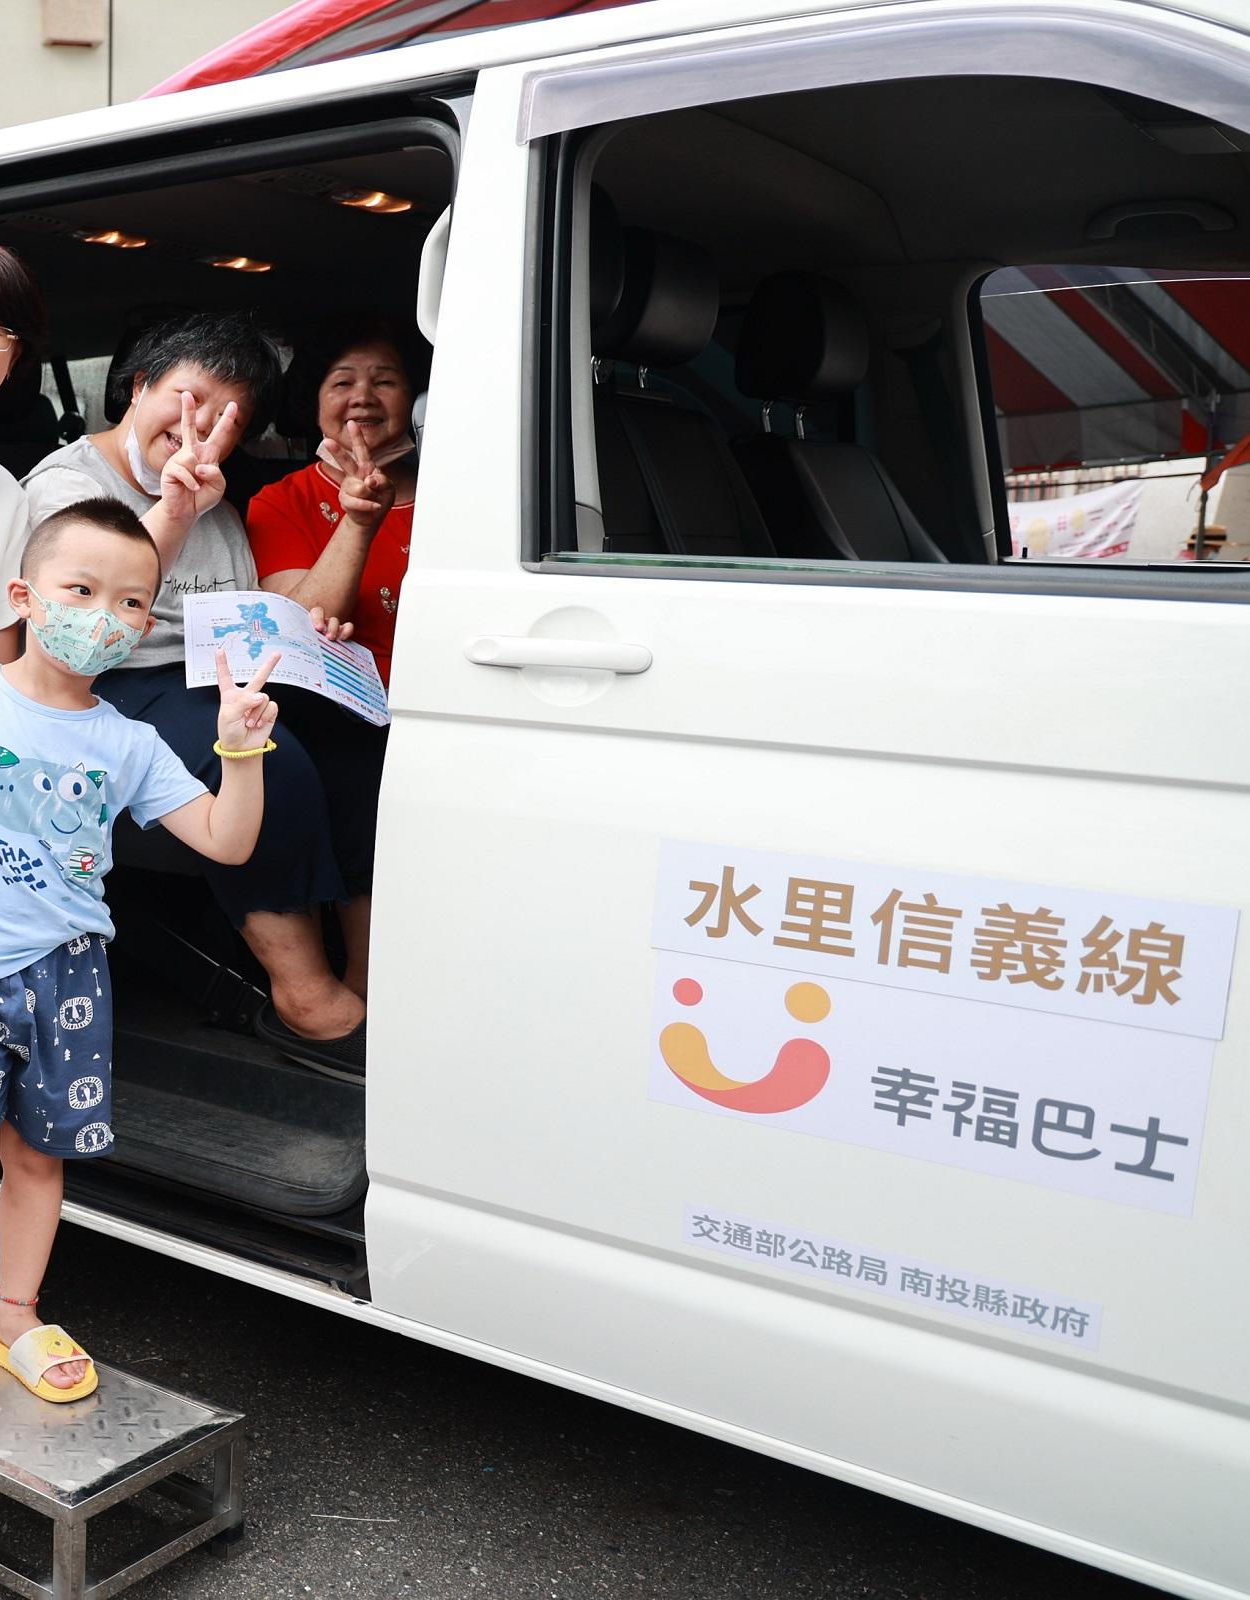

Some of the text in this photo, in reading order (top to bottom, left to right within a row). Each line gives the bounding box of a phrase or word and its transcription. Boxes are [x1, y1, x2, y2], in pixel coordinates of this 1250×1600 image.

[683, 865, 1186, 1007] 水里信義線
[871, 1066, 1189, 1182] 幸福巴士
[691, 1213, 1091, 1339] 交通部公路局 南投縣政府
